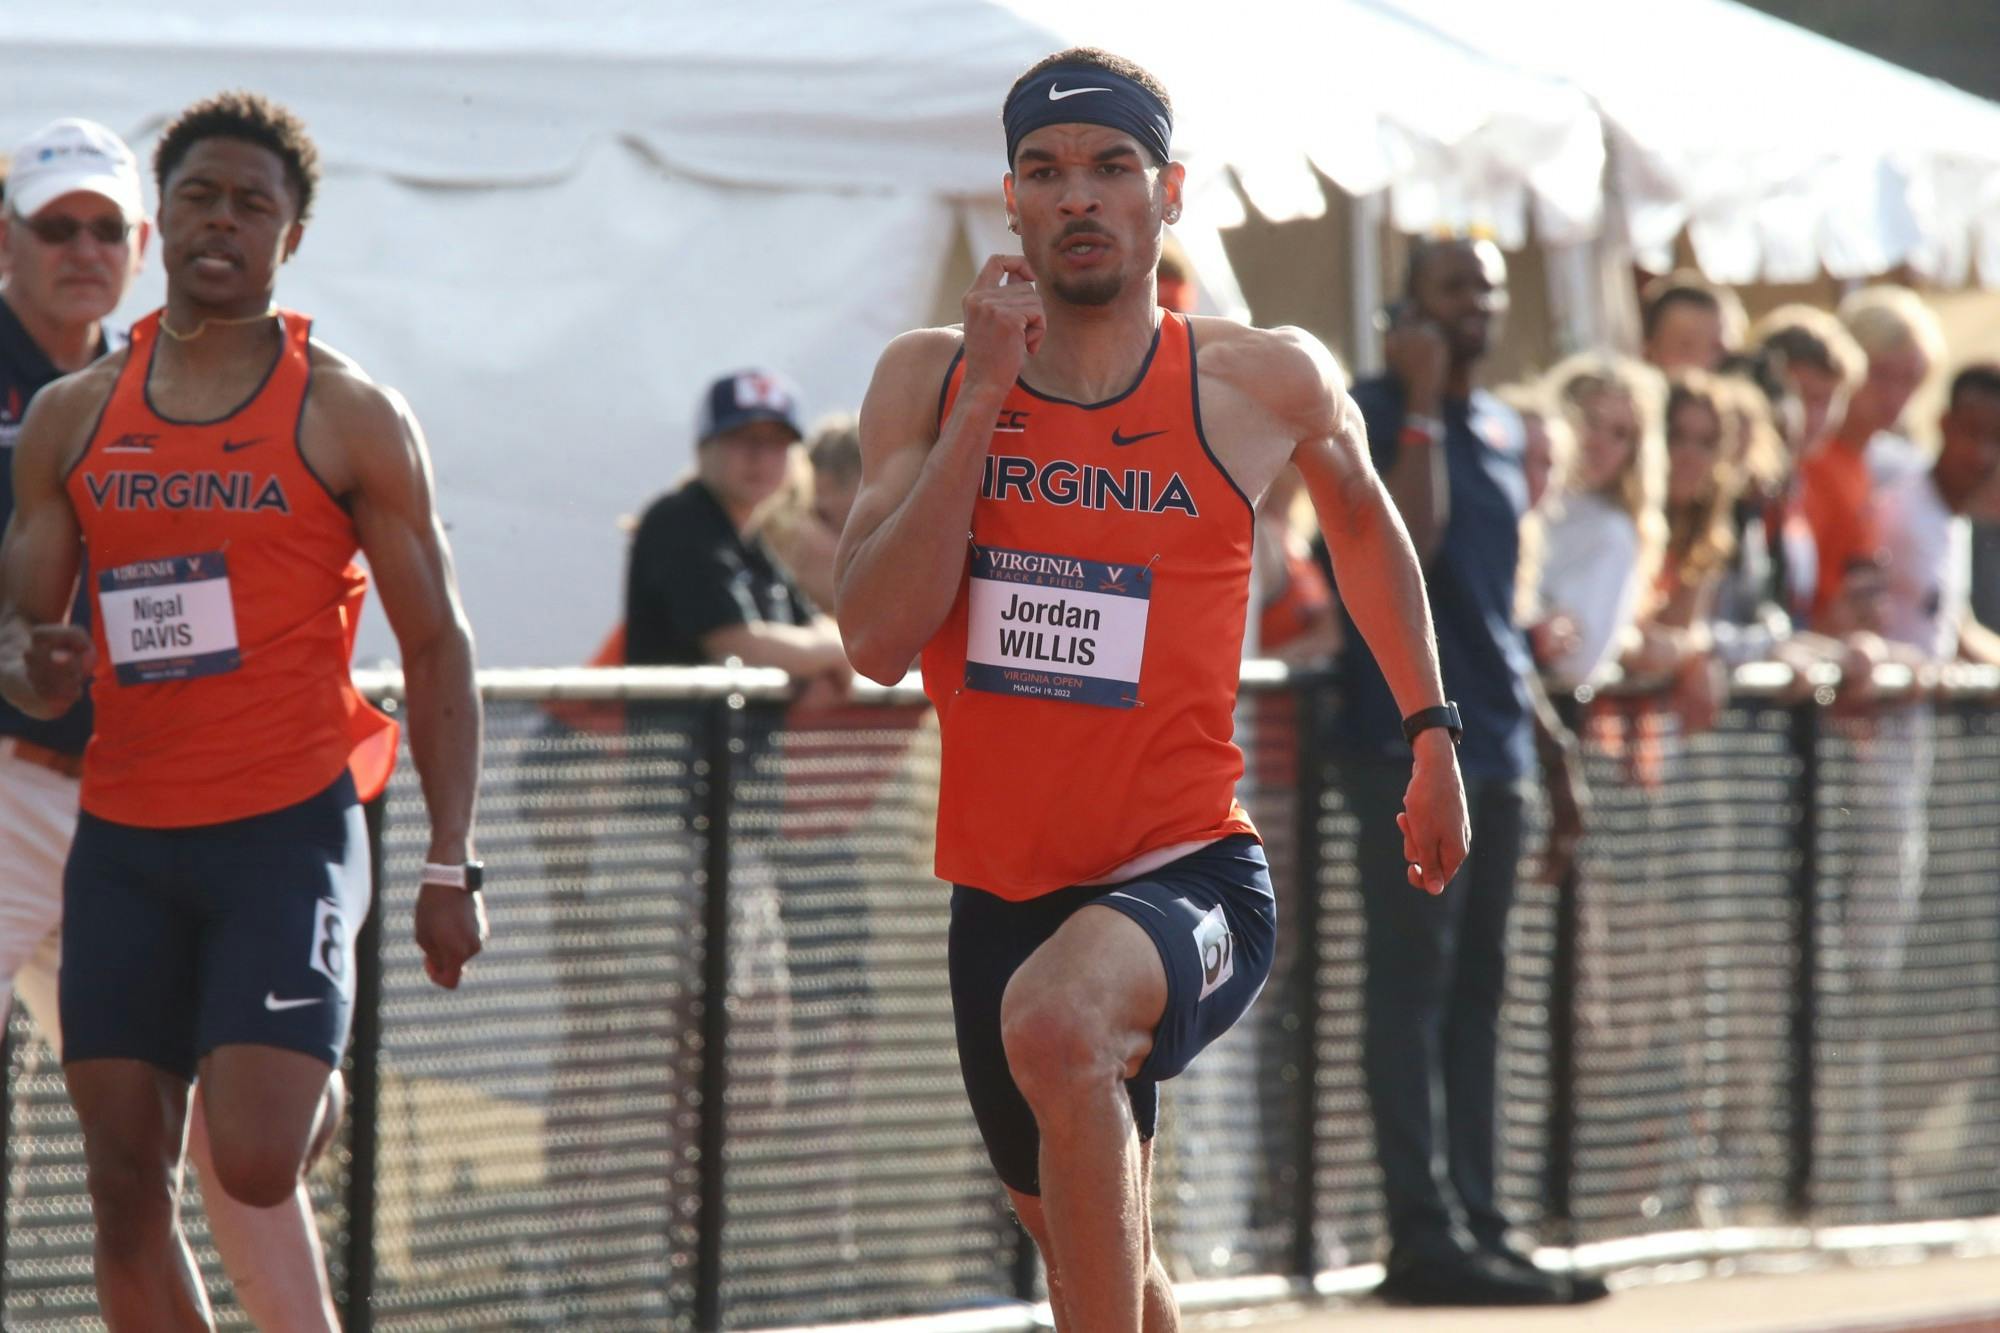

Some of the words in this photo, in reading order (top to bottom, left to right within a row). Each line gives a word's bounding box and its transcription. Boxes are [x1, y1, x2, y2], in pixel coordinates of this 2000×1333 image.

[995, 410, 1030, 428] CC
[84, 470, 292, 516] VIRGINIA
[980, 455, 1199, 517] IRGINIA
[988, 551, 1085, 579] VIRGINIA
[989, 569, 1029, 583] TRACK
[1035, 573, 1044, 586] &
[1050, 577, 1084, 590] FIELD
[133, 593, 184, 624] Nigal
[1001, 594, 1100, 630] Jordan
[131, 622, 192, 652] DAVIS
[1000, 628, 1096, 666] WILLIS
[1003, 671, 1050, 684] VIRGINIA
[1053, 676, 1084, 689] OPEN
[1013, 684, 1041, 694] MARCH
[1055, 688, 1071, 697] 2022
